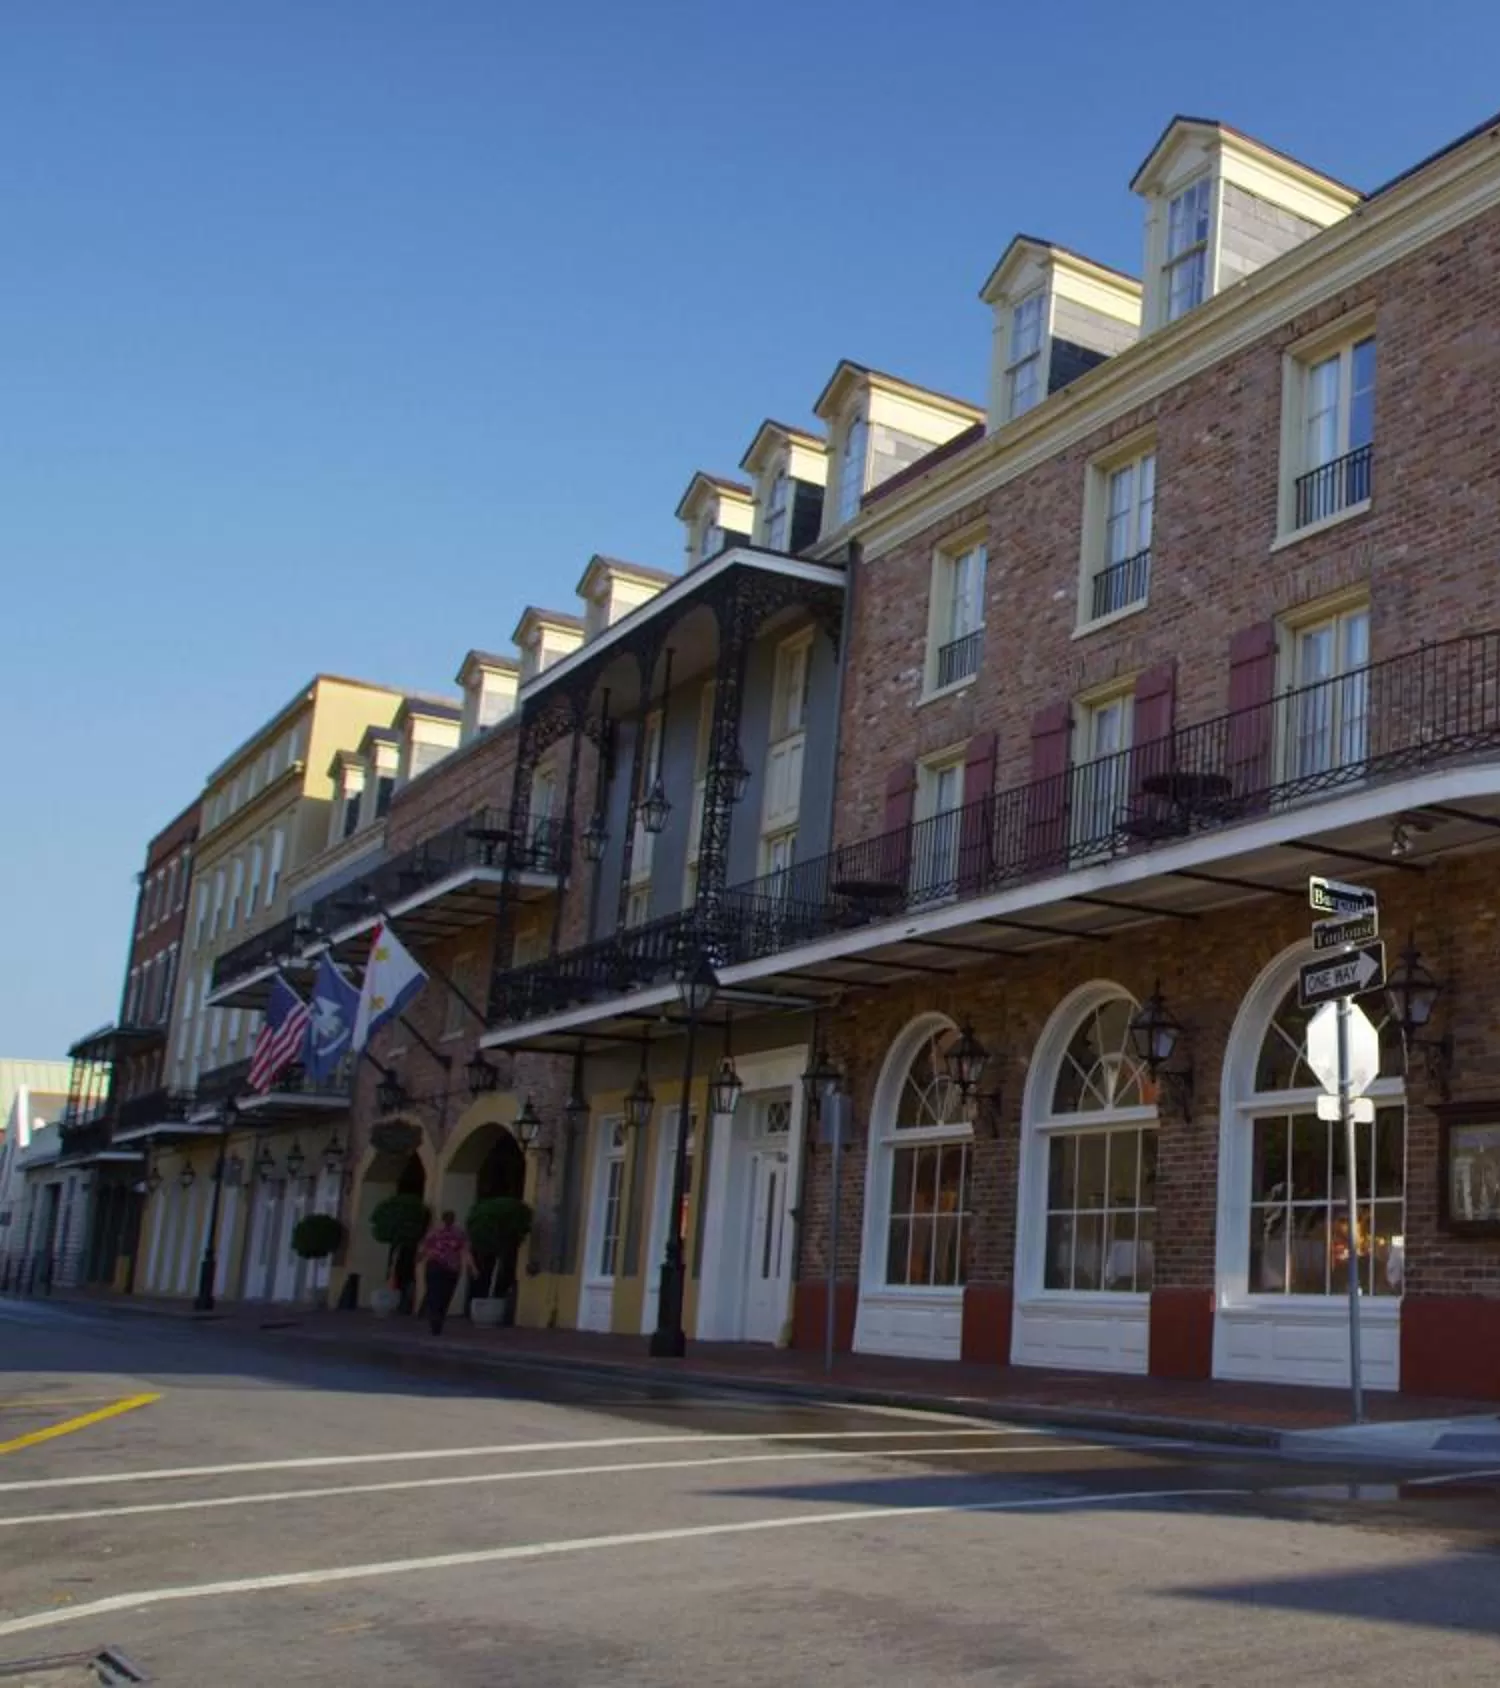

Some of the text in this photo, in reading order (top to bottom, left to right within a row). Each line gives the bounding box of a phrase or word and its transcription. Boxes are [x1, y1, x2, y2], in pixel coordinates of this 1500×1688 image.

[1315, 923, 1376, 947] Toulouse
[1308, 962, 1359, 993] ONE WAY
